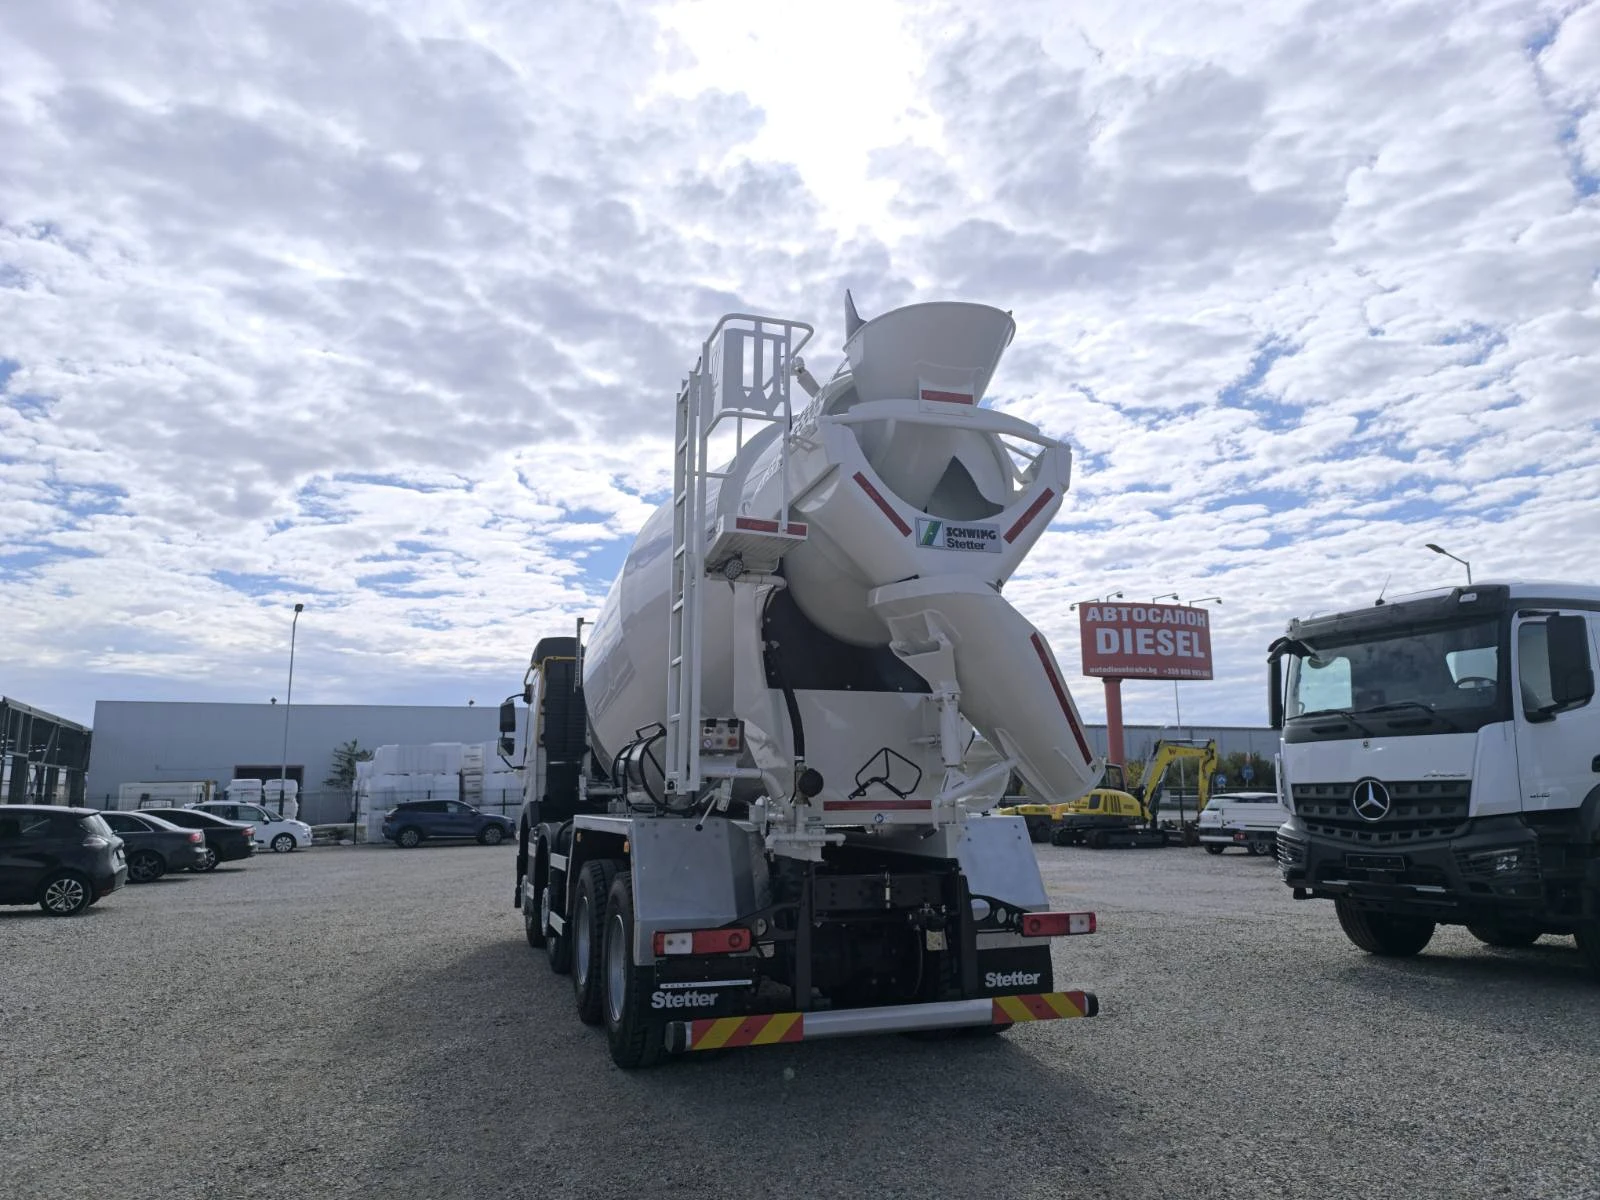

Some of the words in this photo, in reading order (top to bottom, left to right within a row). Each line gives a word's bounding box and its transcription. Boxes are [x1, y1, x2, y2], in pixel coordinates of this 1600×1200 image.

[946, 526, 997, 540] SCHWING
[946, 537, 986, 550] Stetter
[1086, 606, 1206, 627] АВТОСАЛОН
[1095, 627, 1206, 658] DIESEL
[984, 970, 1041, 988] Stetter
[651, 990, 719, 1009] Stetter
